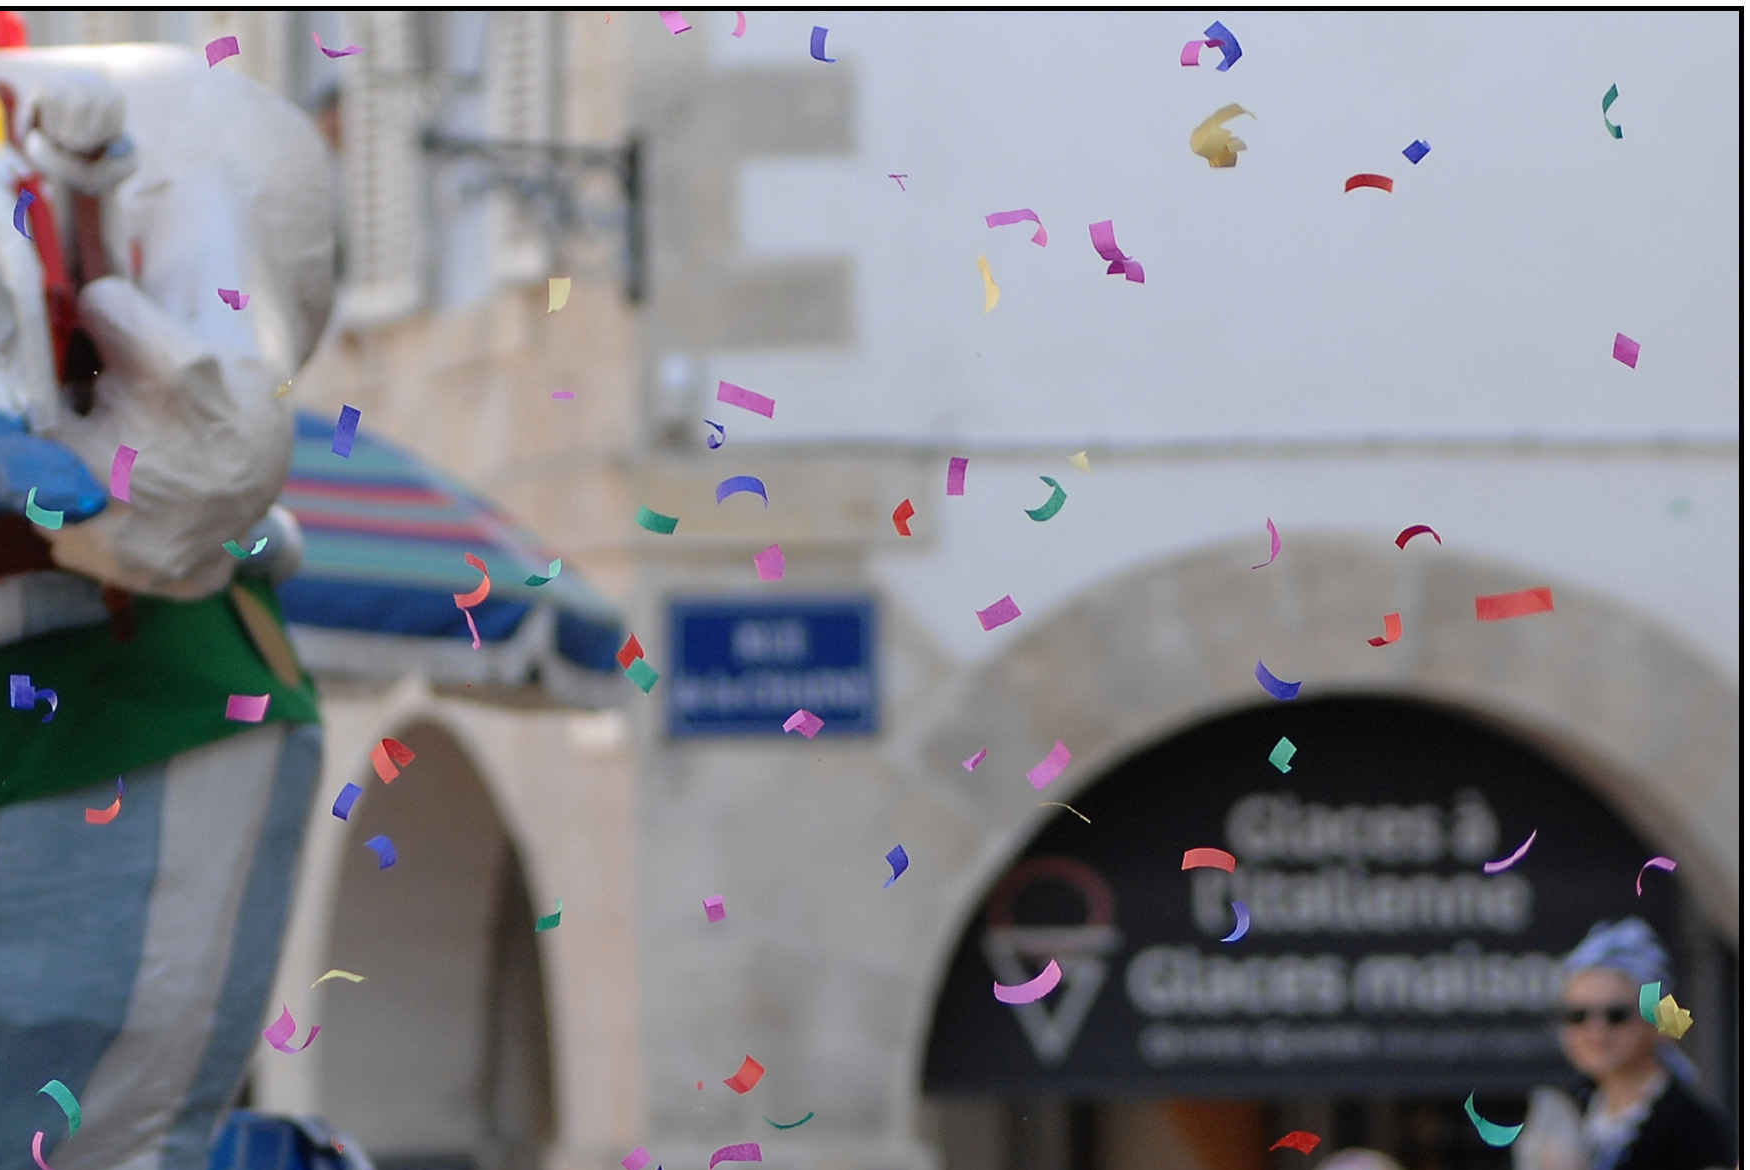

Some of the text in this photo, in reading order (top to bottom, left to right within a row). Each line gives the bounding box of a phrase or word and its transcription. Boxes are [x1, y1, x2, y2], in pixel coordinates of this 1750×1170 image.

[1225, 794, 1444, 863] Glaces
[1192, 864, 1533, 933] l'italienne
[1126, 942, 1563, 1016] Glaces maiso
